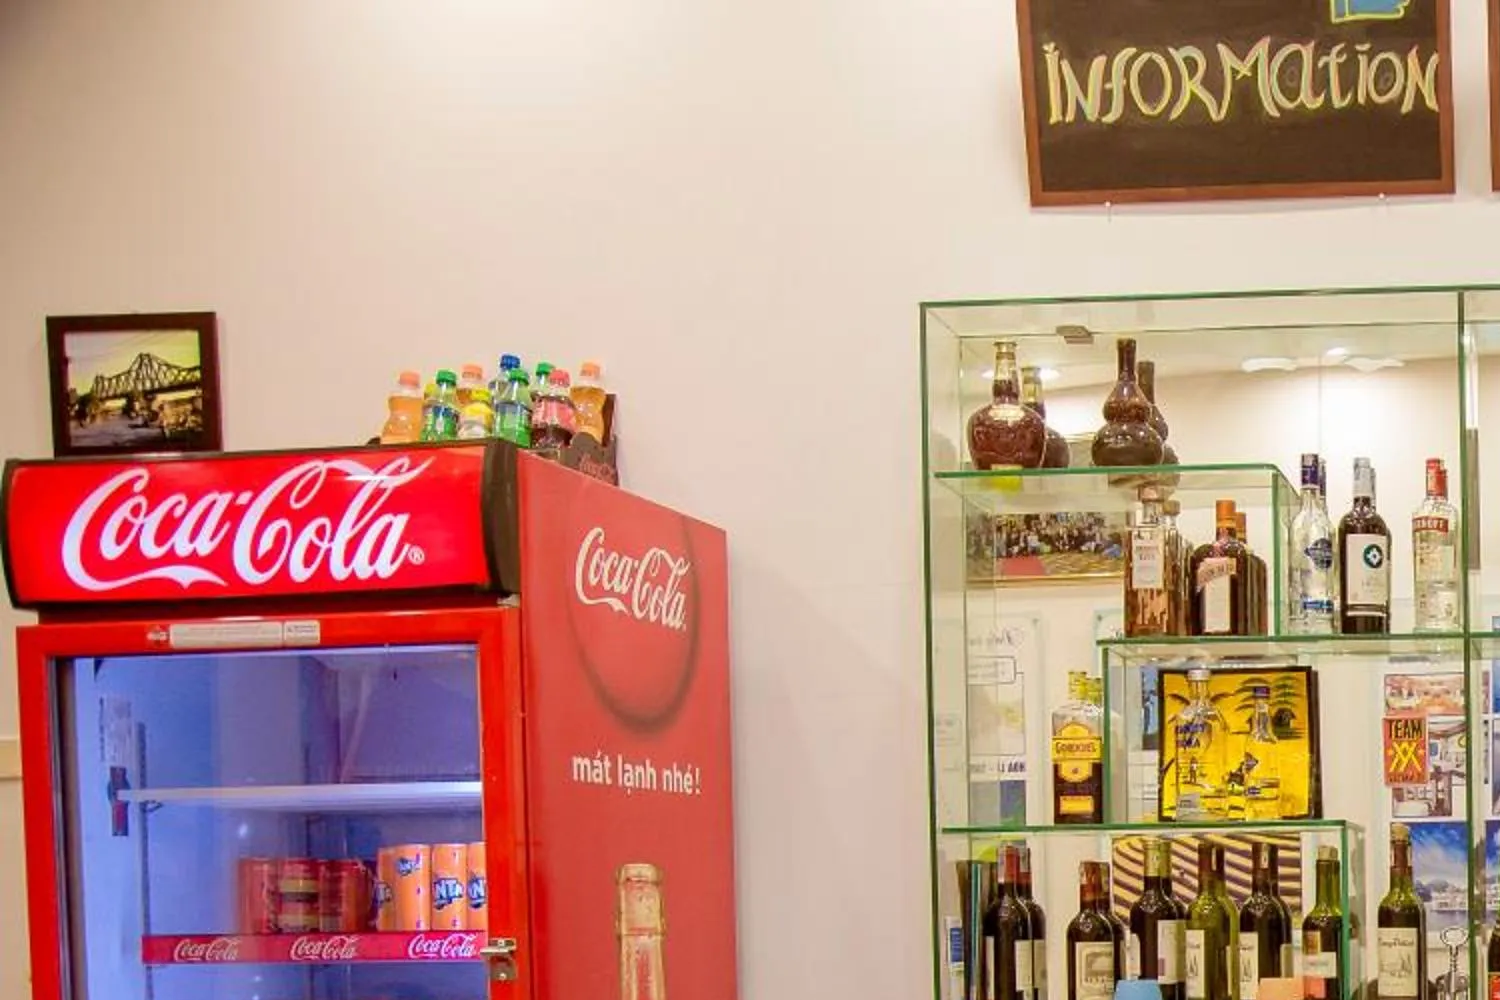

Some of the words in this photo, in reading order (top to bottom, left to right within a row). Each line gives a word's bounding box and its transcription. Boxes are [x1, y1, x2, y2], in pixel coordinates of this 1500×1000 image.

[61, 455, 434, 591] Coca-Cola
[1388, 719, 1424, 740] TEAM
[572, 749, 613, 785] mát
[617, 753, 657, 795] lạnh
